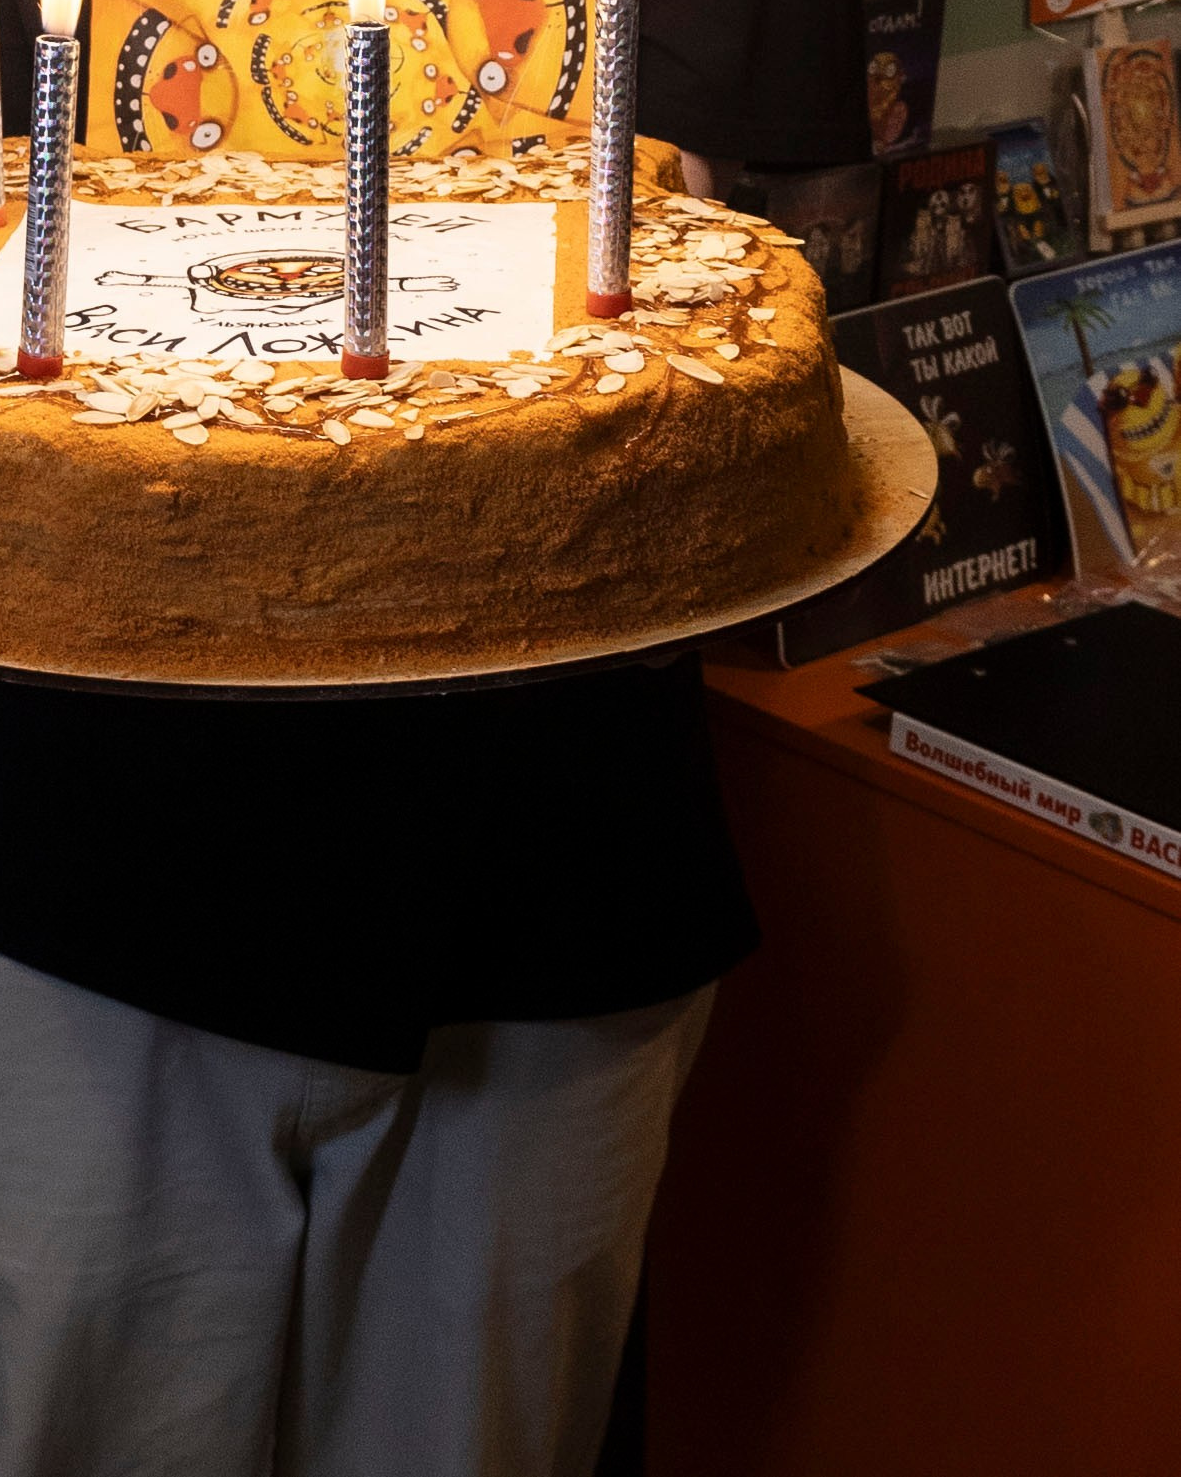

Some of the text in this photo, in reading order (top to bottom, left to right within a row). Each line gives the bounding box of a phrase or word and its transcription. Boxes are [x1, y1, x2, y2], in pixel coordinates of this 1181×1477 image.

[115, 209, 492, 234] БАРМУЕЙ
[207, 306, 501, 356] ЛОЖИНА
[902, 310, 973, 351] ТАК ВОТ
[909, 335, 999, 383] ТЫ КАКОЙ
[922, 537, 1038, 605] ИНТЕРНЕТ!
[905, 730, 1181, 867] Волшебный мир ВАС
